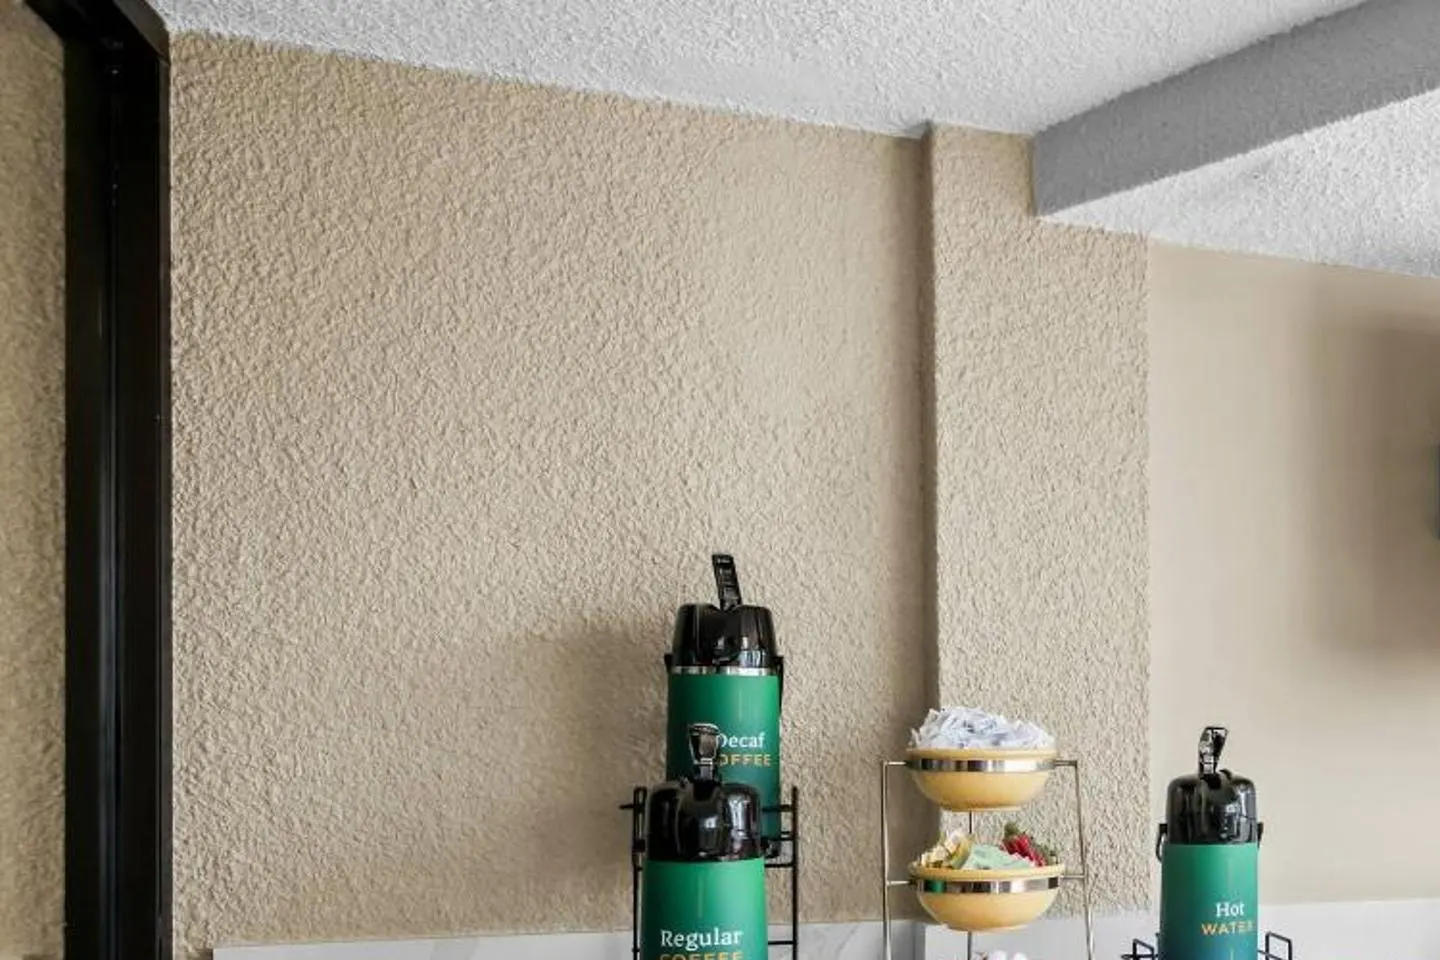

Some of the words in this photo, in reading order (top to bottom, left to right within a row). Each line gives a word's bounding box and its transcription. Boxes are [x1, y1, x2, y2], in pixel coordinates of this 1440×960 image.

[718, 754, 771, 767] OFFEE
[1216, 901, 1245, 917] Hot
[661, 927, 744, 951] Regular
